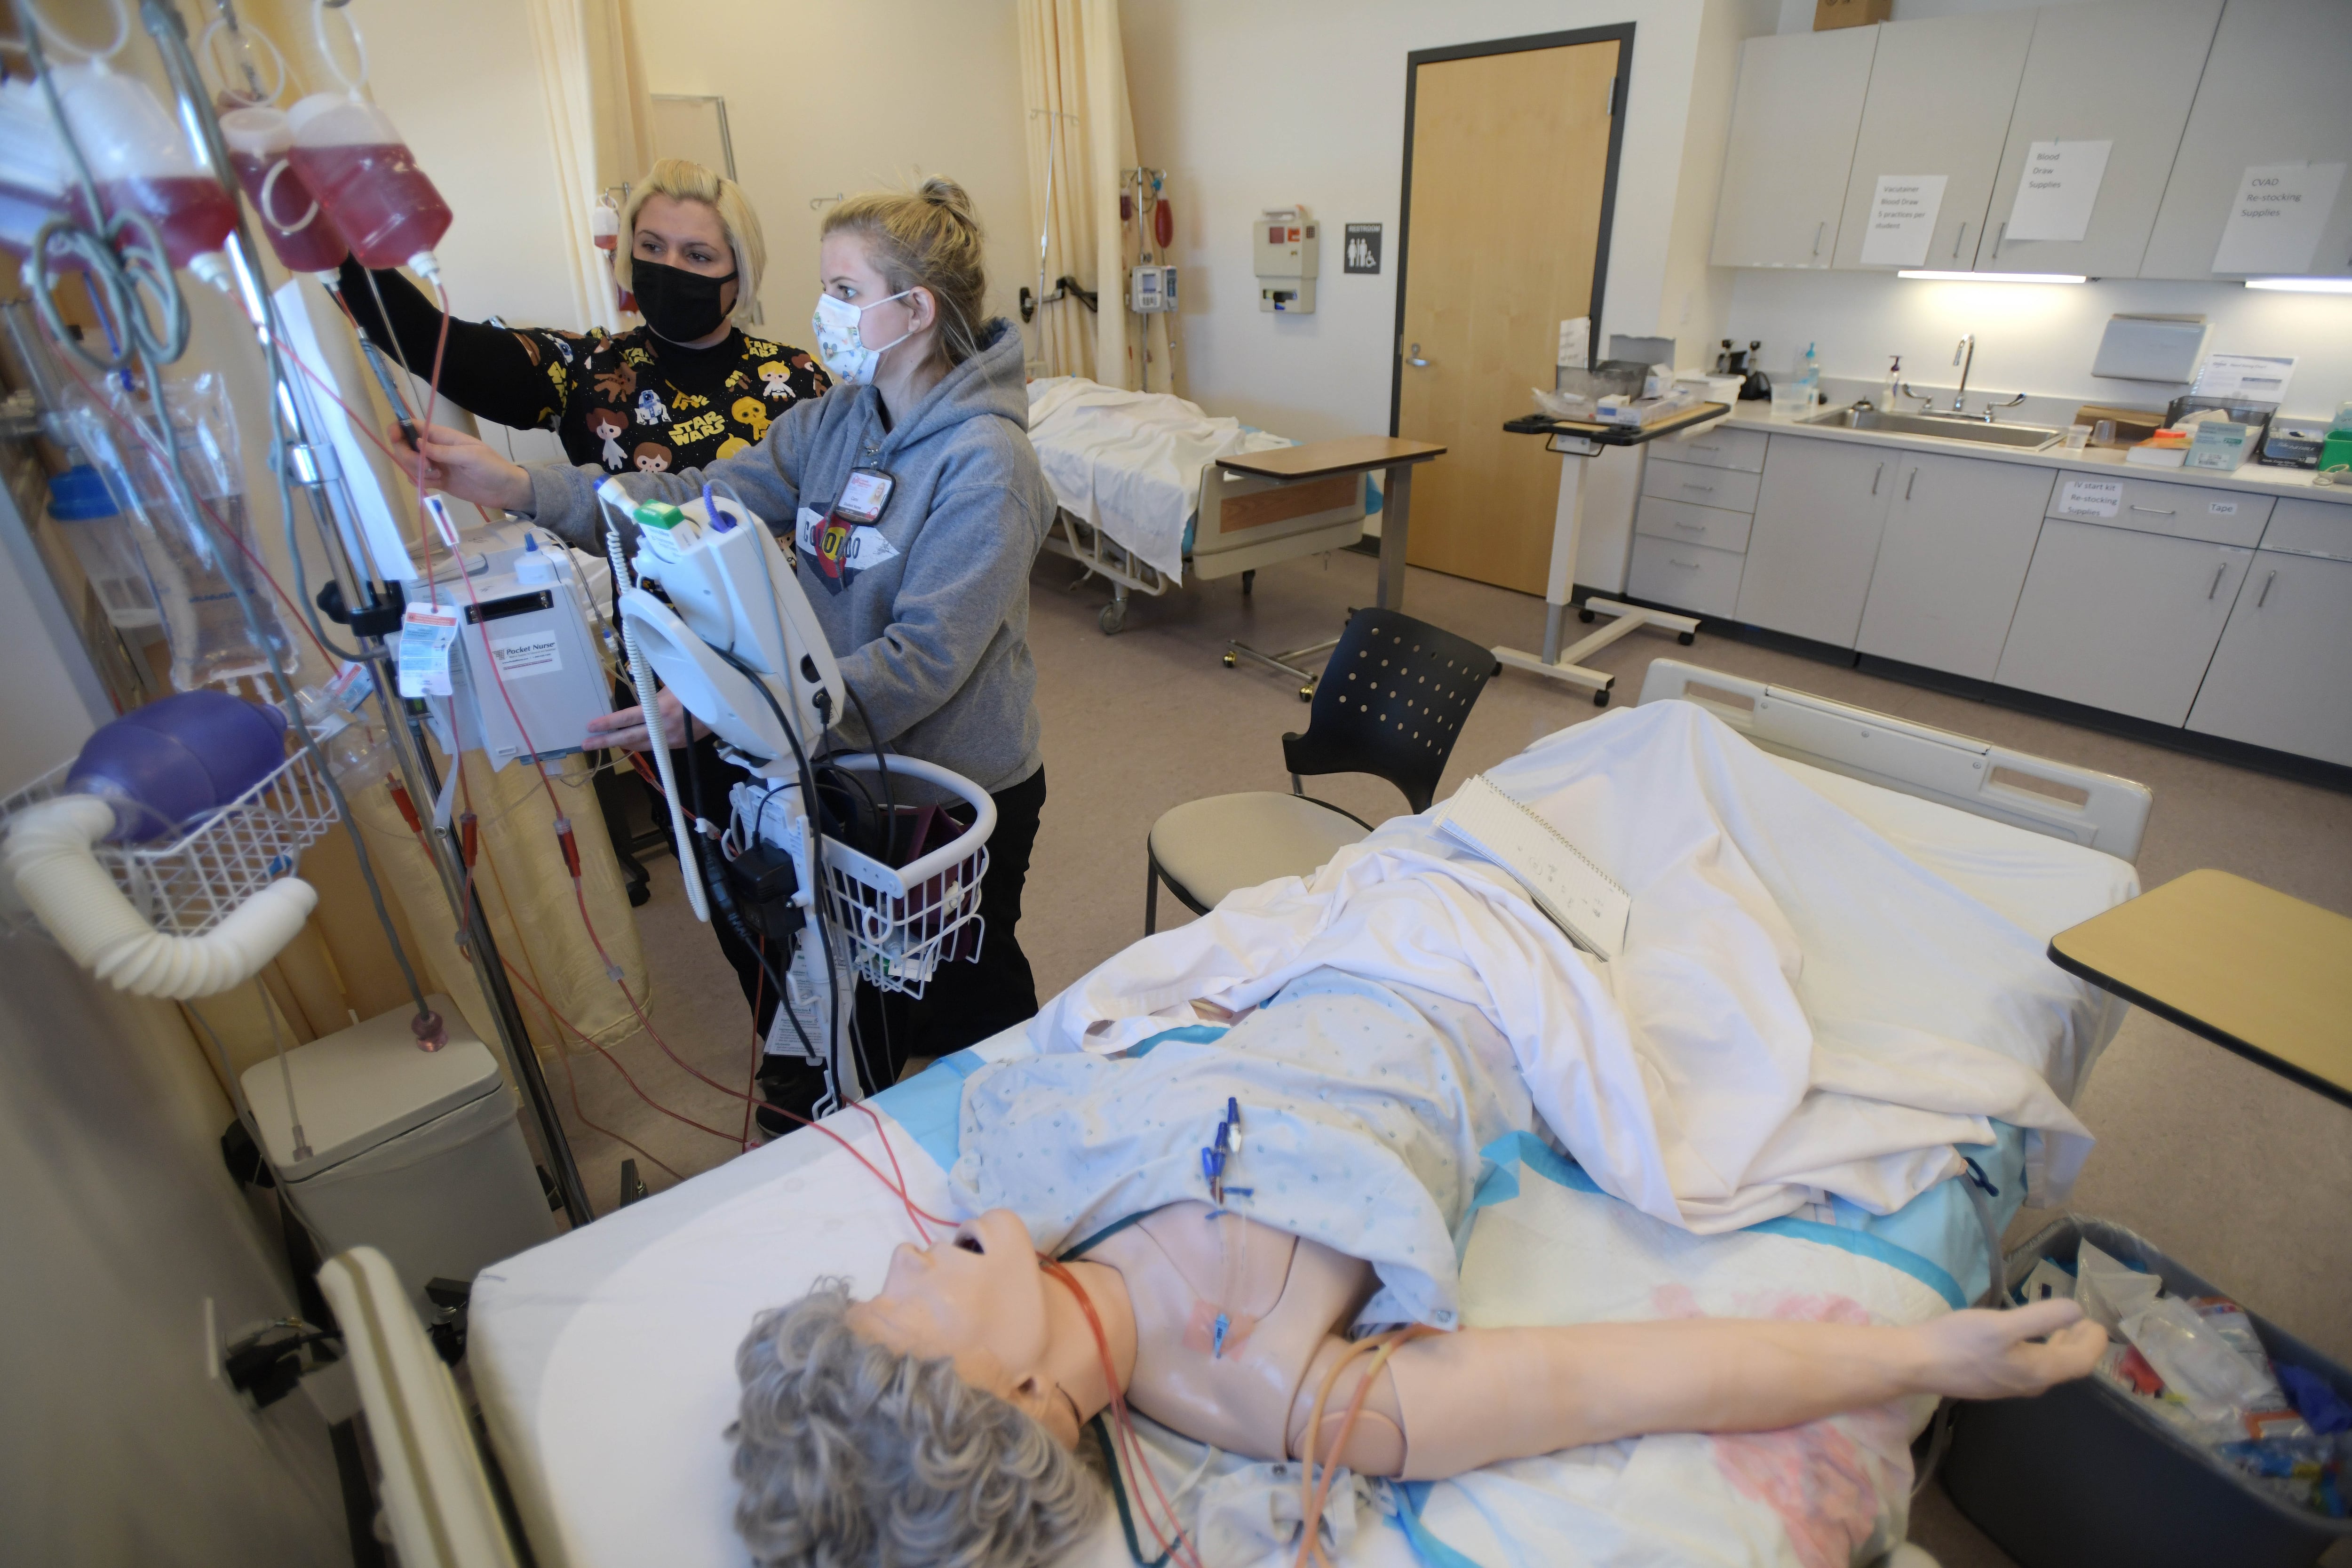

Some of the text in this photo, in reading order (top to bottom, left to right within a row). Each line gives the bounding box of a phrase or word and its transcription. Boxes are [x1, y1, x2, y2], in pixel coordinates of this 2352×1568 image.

[2028, 180, 2061, 189] Supplies
[2251, 178, 2280, 187] CVAD
[2246, 193, 2302, 202] Re-stocking
[2241, 208, 2281, 218] Supplies
[1348, 225, 1381, 233] RESTROOM
[668, 411, 723, 436] STAR
[670, 418, 725, 446] WARS
[2070, 493, 2118, 506] Re-stocking
[2067, 506, 2101, 516] Supplies
[2211, 503, 2233, 513] Tape
[803, 520, 861, 559] COODO
[506, 645, 531, 655] Pocket
